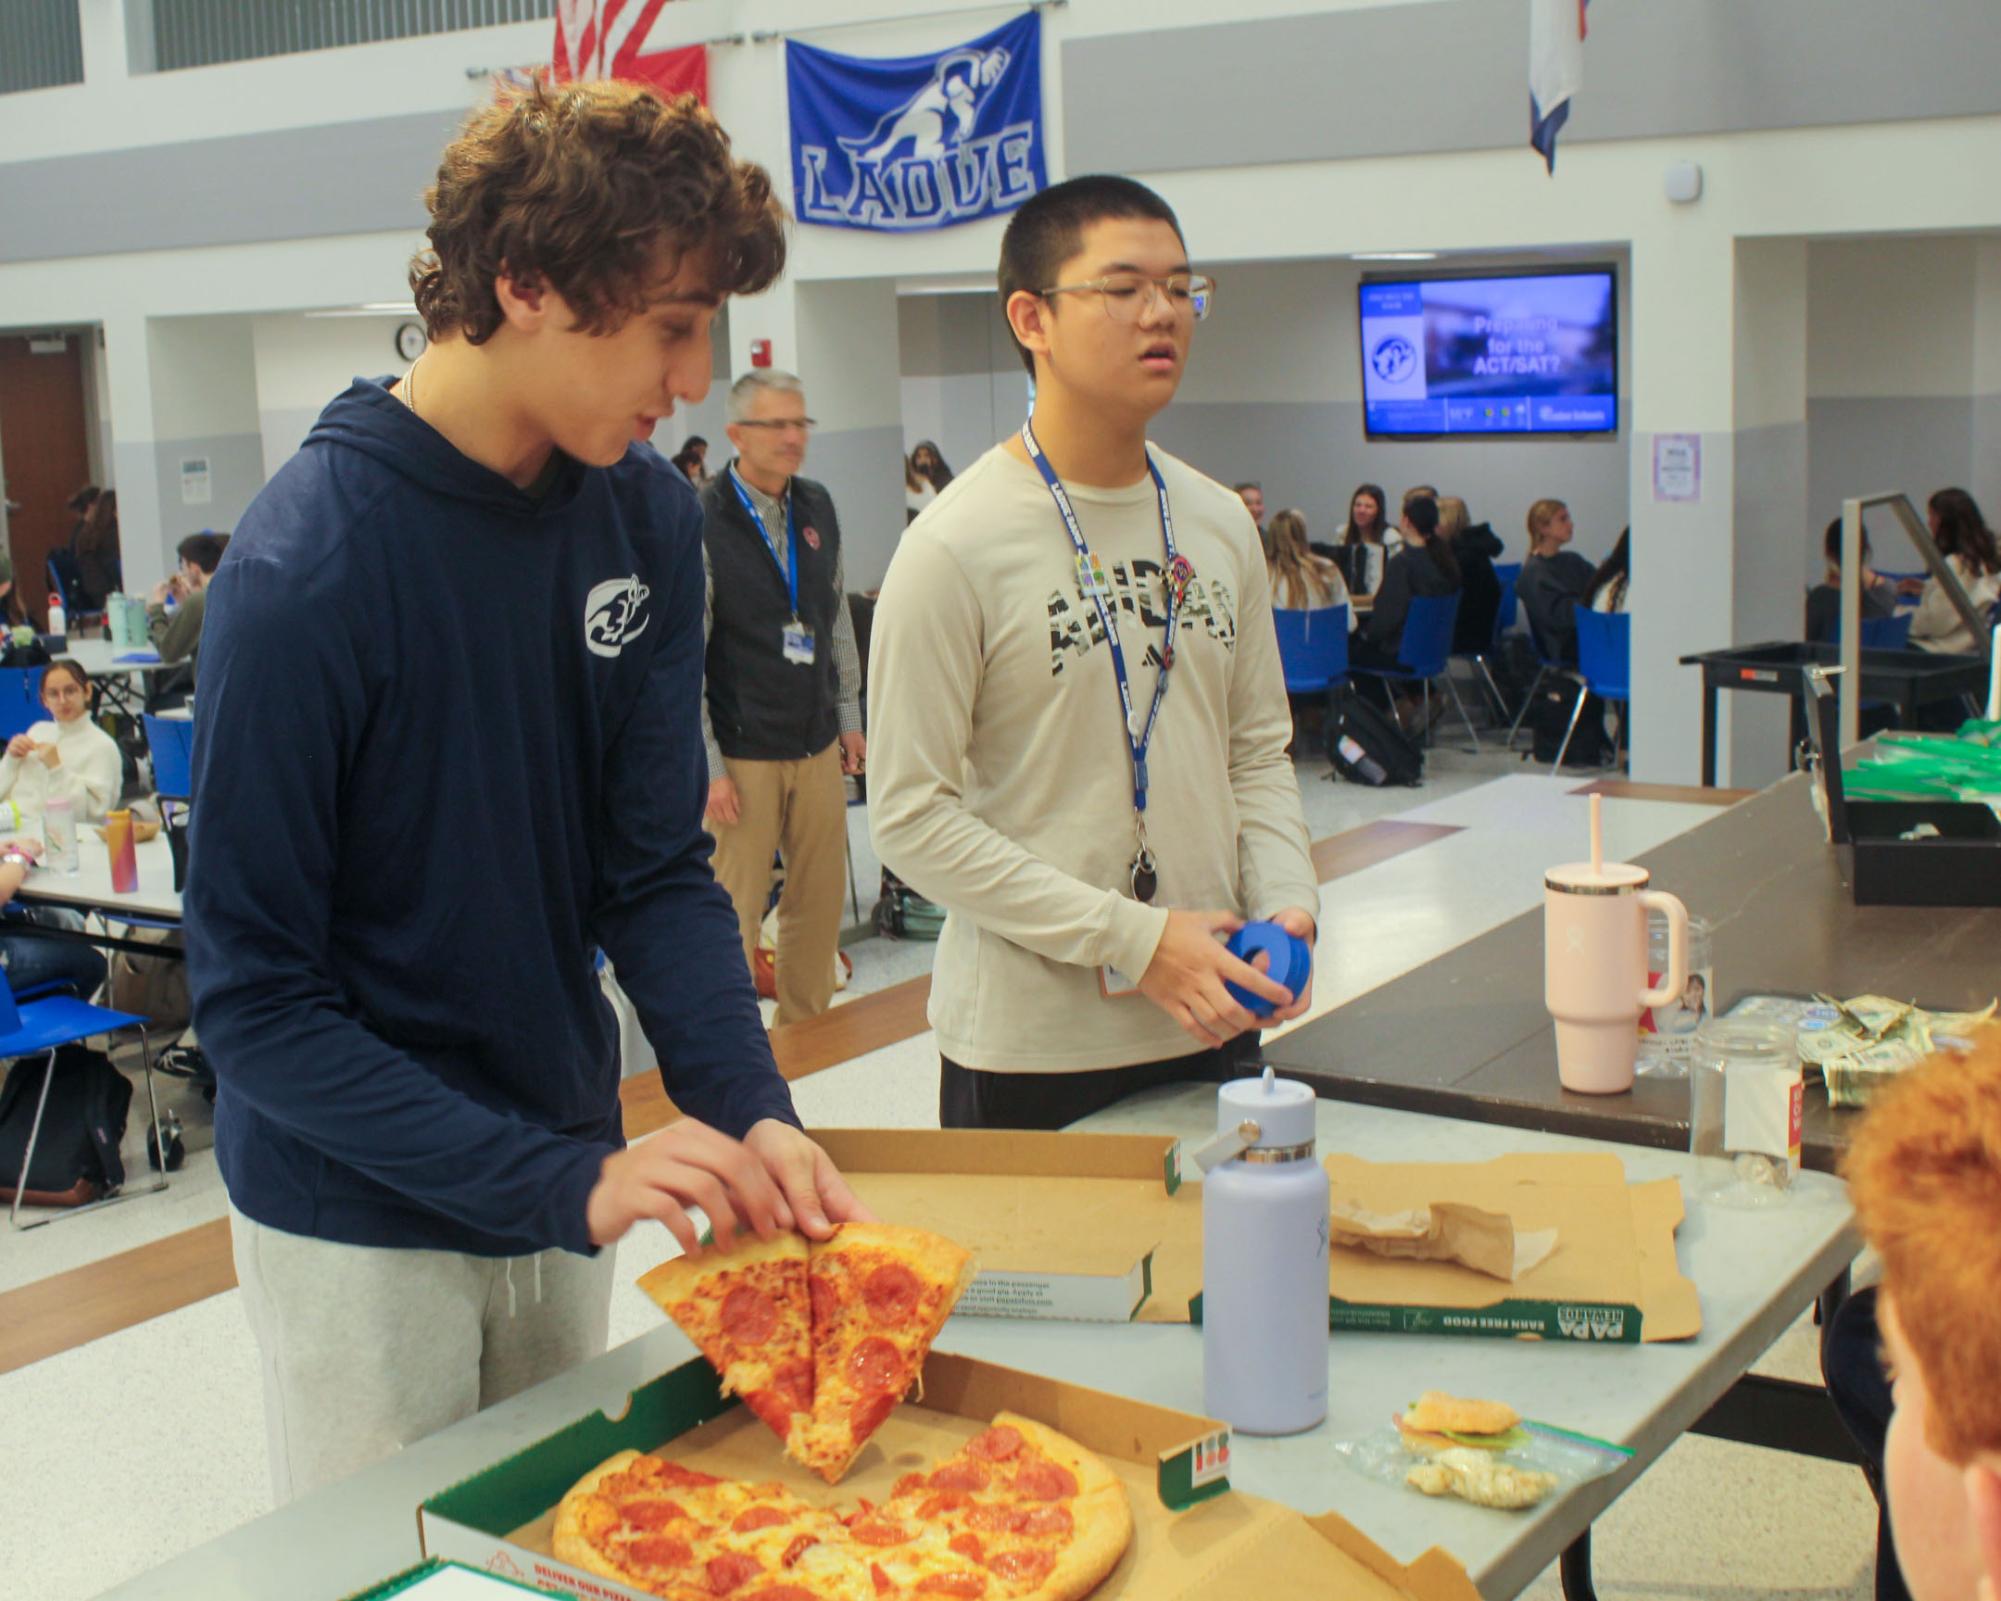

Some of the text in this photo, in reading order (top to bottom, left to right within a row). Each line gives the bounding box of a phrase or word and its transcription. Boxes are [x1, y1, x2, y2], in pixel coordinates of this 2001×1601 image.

[802, 121, 1037, 227] LADUE
[1488, 338, 1545, 353] for the
[1474, 355, 1560, 375] ACT/SAT?
[1443, 1316, 1545, 1331] EARN FREE FOOD
[1559, 1319, 1624, 1339] PAPA
